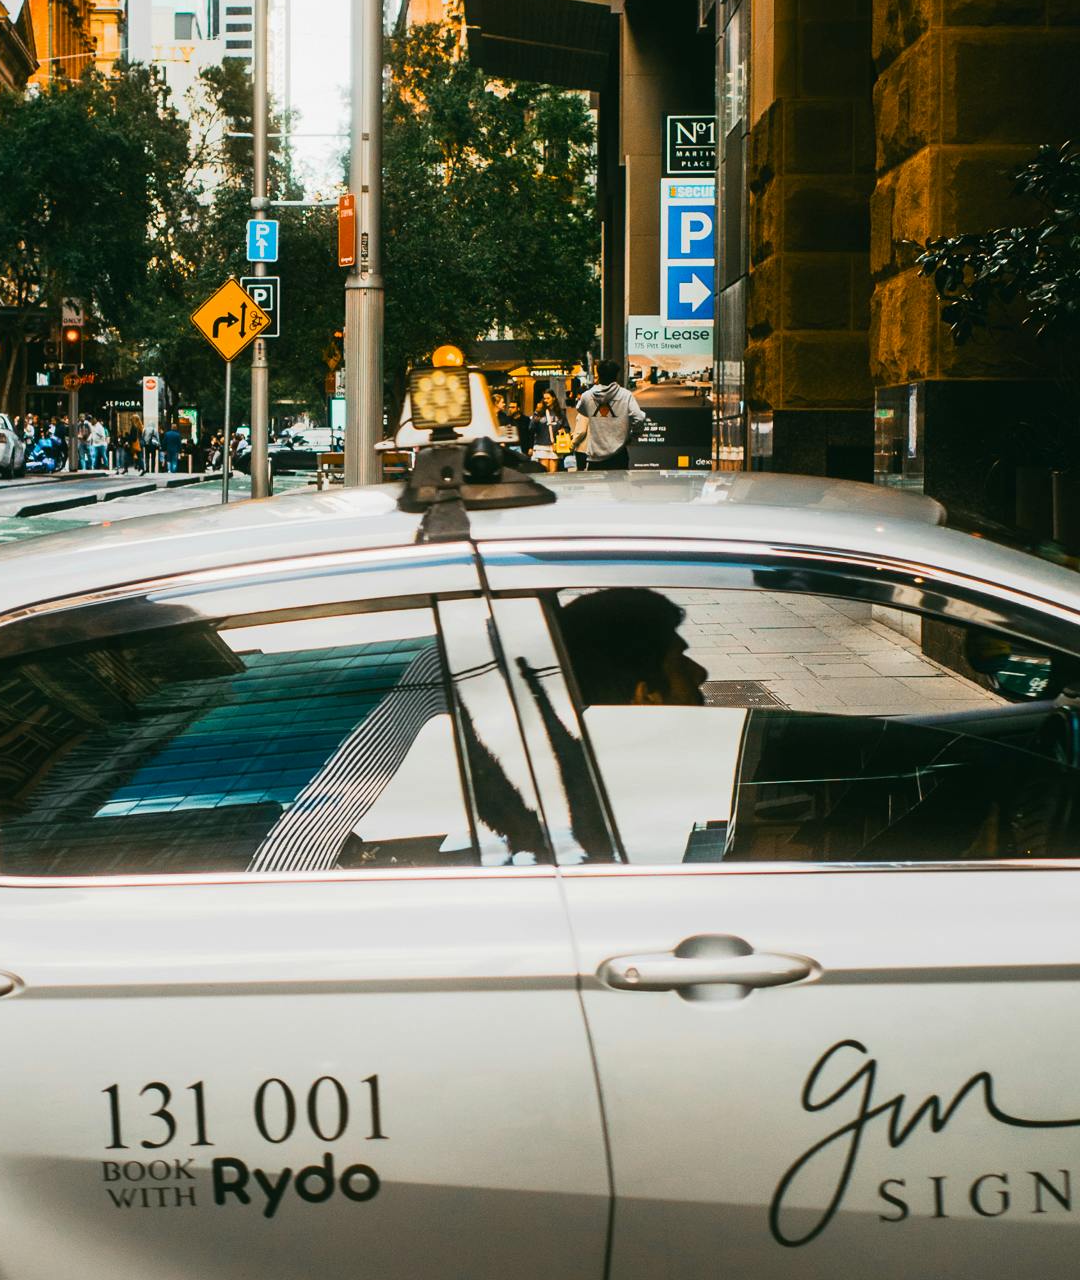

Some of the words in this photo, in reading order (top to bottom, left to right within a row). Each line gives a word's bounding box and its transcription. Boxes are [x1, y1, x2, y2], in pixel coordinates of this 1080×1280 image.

[256, 224, 270, 240] P
[681, 212, 713, 253] P
[254, 289, 267, 306] P
[635, 327, 659, 341] For
[664, 327, 710, 341] Lease
[101, 1080, 216, 1150] 131
[253, 1073, 391, 1144] 001
[101, 1158, 197, 1182] BOOK
[107, 1186, 198, 1209] WITH
[212, 1152, 381, 1219] Rydo
[878, 1169, 1072, 1223] SIGN
